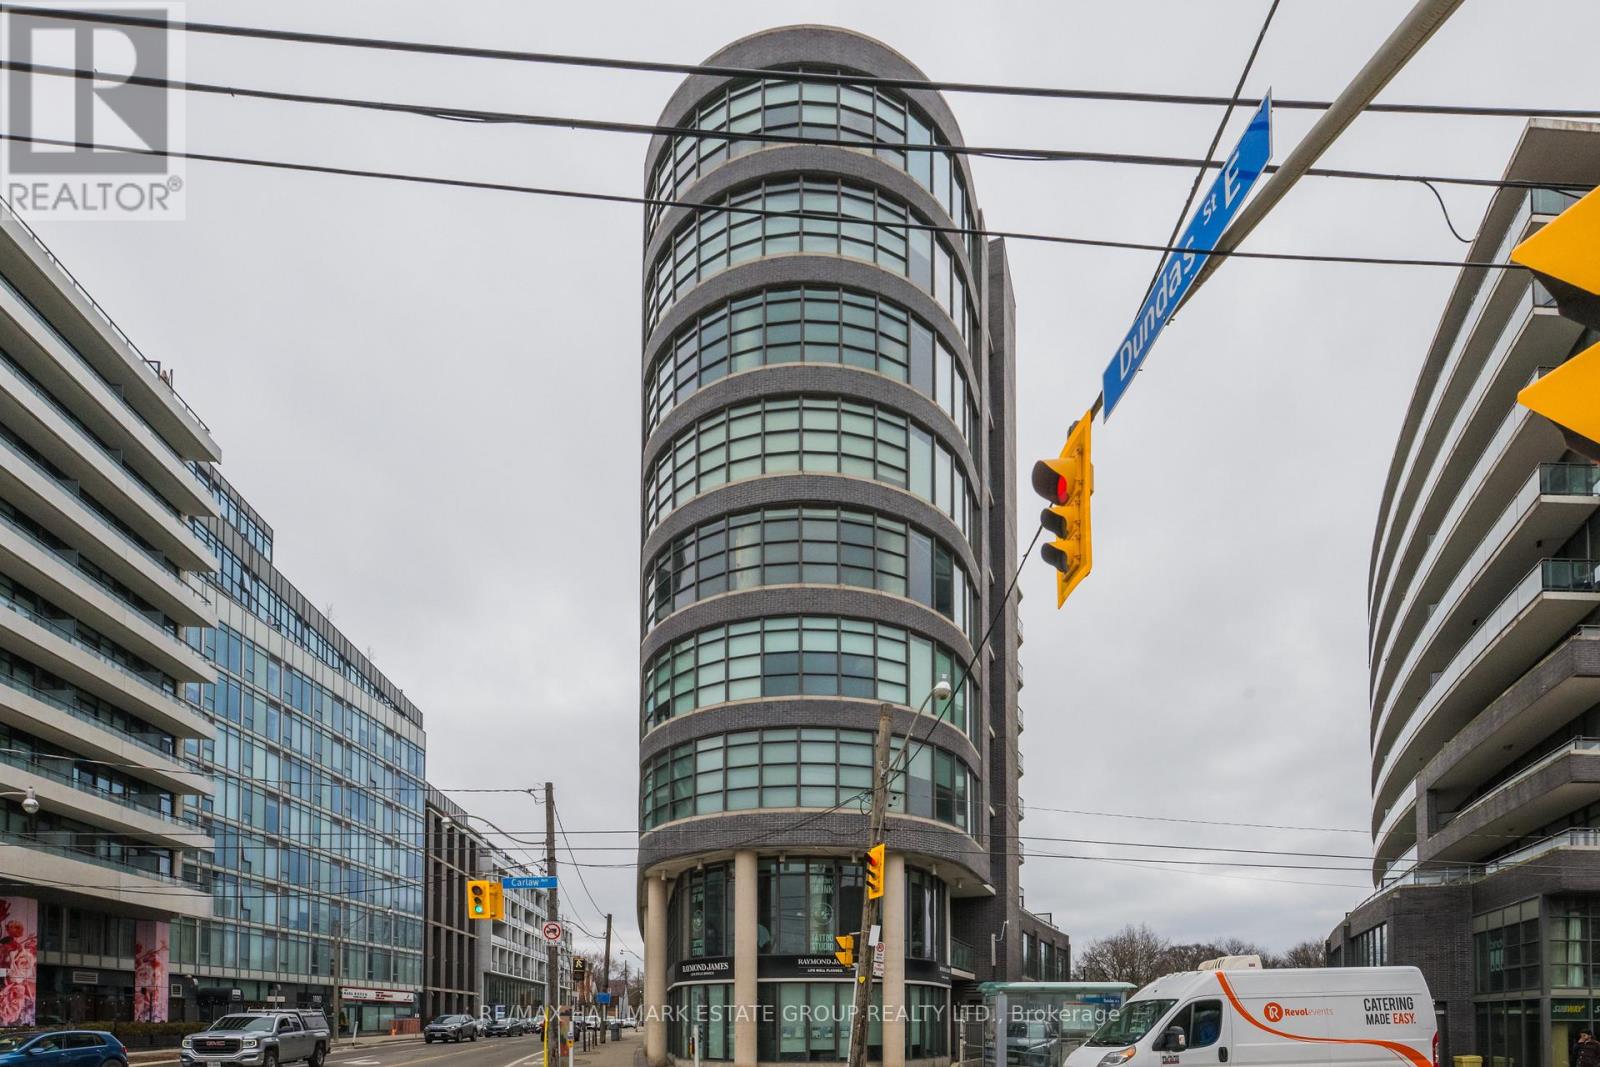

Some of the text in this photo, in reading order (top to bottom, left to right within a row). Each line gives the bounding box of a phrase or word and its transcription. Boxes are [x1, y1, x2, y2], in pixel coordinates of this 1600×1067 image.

[1119, 152, 1241, 381] Dundas St E
[511, 879, 540, 887] Carlaw
[811, 942, 834, 951] STUDIO
[707, 962, 729, 970] JAMES
[1363, 996, 1414, 1012] CATERING
[1552, 1004, 1585, 1013] SUBWAY
[1365, 1013, 1417, 1025] MADE EASY.
